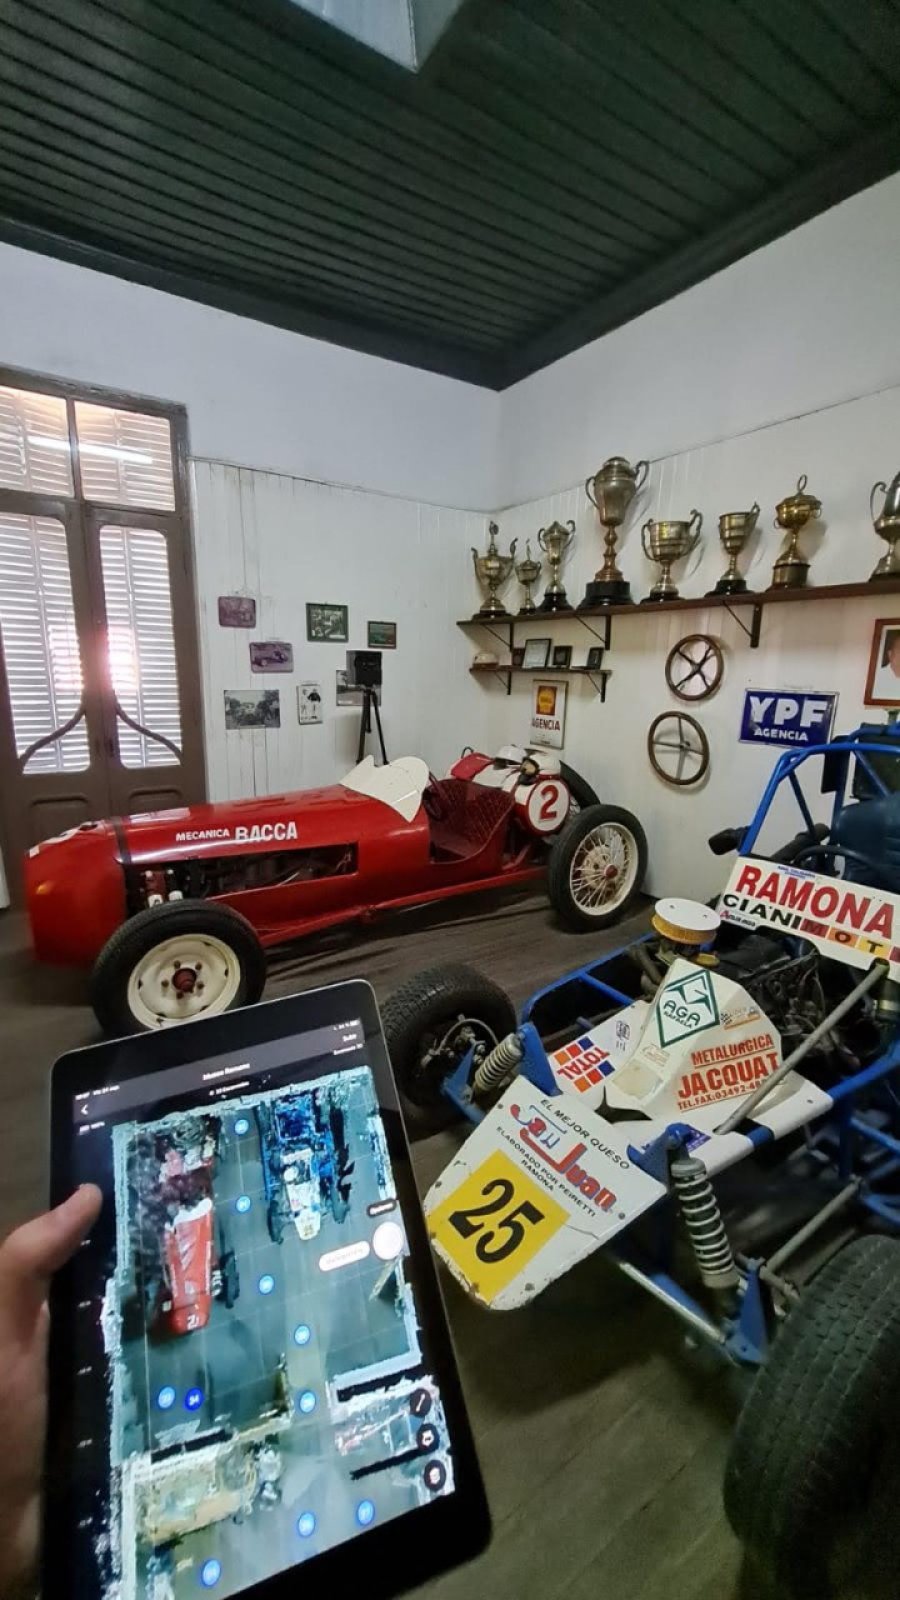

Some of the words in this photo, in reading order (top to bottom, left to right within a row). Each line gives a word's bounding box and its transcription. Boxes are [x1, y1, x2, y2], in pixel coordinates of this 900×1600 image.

[531, 717, 561, 732] AGENCIA
[749, 695, 828, 728] YPF
[753, 728, 809, 741] AGENCIA
[539, 784, 559, 820] 2
[175, 828, 230, 841] MECANICA
[234, 821, 298, 844] BACCA
[736, 864, 895, 940] RAMONA
[663, 999, 701, 1026] AGA
[556, 1046, 610, 1080] TOTAL
[691, 1033, 774, 1066] METALURGICA
[677, 1052, 780, 1099] JACQUAT
[540, 1099, 553, 1111] EL
[554, 1109, 590, 1139] MEJOR
[590, 1136, 630, 1170] QUESO
[496, 1126, 541, 1167] ELABORADO
[541, 1166, 560, 1184] POR
[559, 1182, 596, 1217] PEIRETTI
[519, 1127, 618, 1213] Juan
[520, 1159, 554, 1192] RAMONA
[448, 1178, 546, 1265] 25
